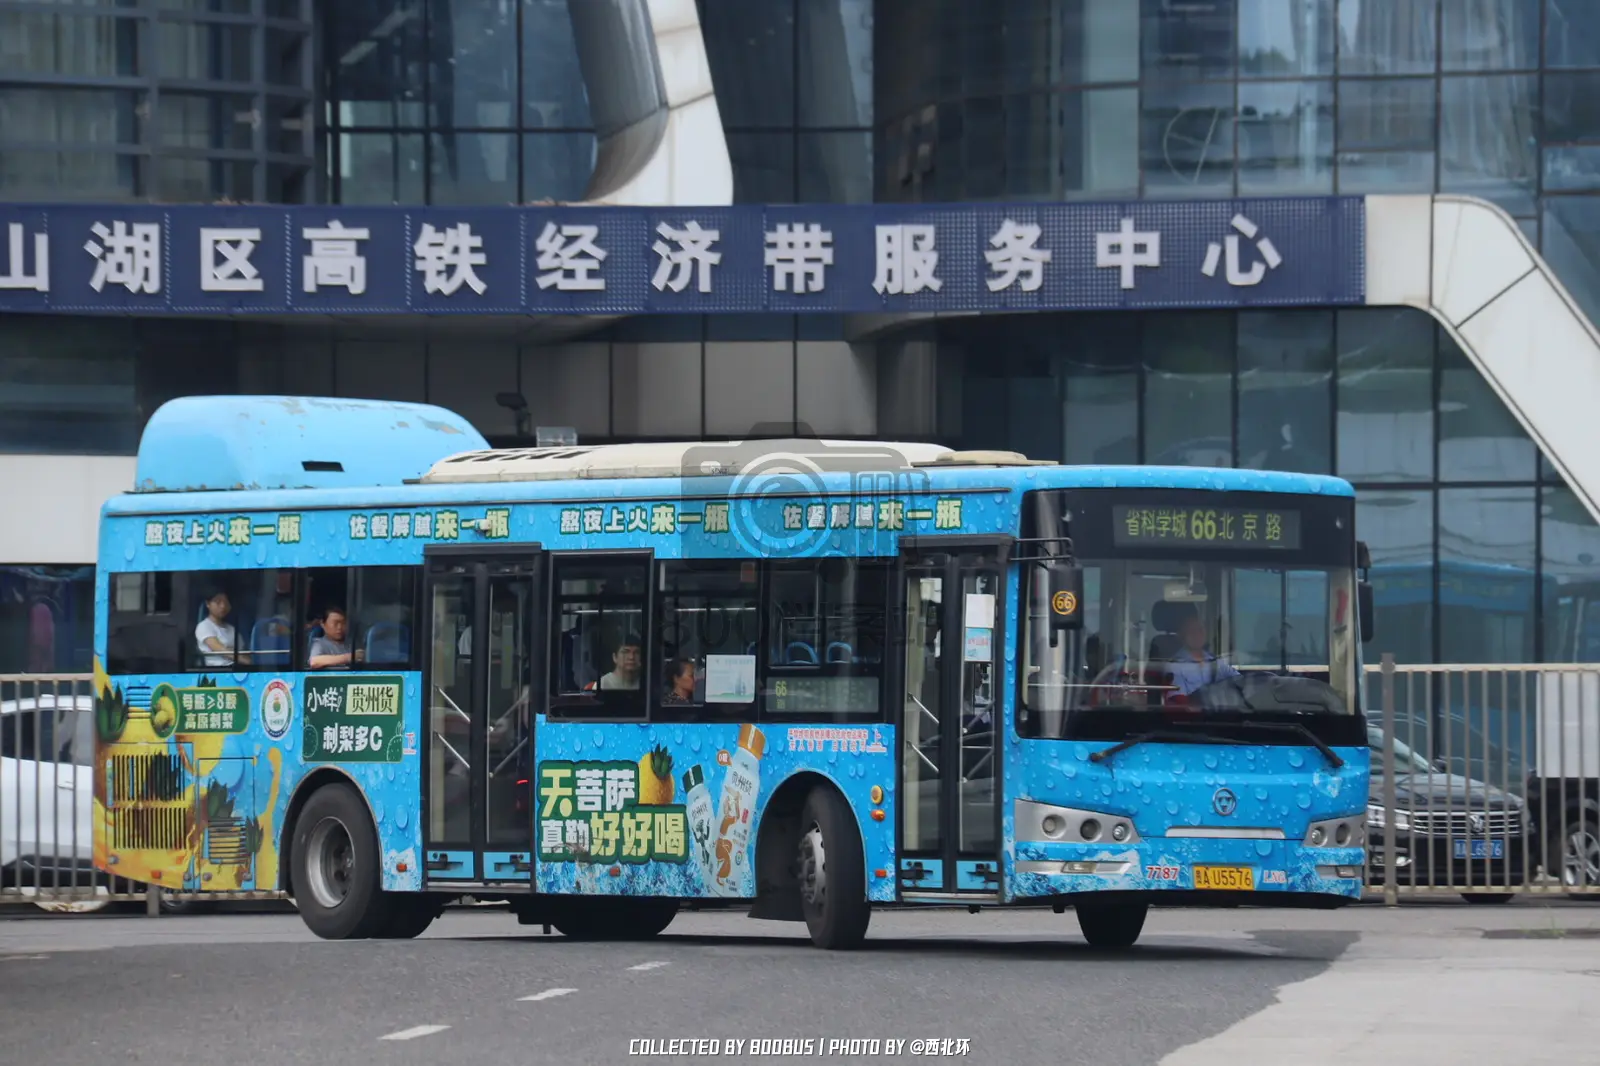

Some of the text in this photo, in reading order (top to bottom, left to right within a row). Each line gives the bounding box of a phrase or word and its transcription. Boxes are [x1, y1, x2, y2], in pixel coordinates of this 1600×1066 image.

[0, 214, 1282, 298] 山湖区高铁经济带服务中心
[145, 513, 301, 546] 熬夜上火来一瓶
[560, 502, 729, 534] 熬夜上火来一瓶
[1191, 511, 1216, 540] 66
[1218, 511, 1282, 541] 北京路
[1056, 597, 1074, 610] 66
[351, 686, 394, 713] 贵州货
[775, 681, 787, 697] 66
[323, 723, 383, 754] 刺梨多C
[540, 768, 636, 818] 天菩萨
[1146, 866, 1179, 881] 7787
